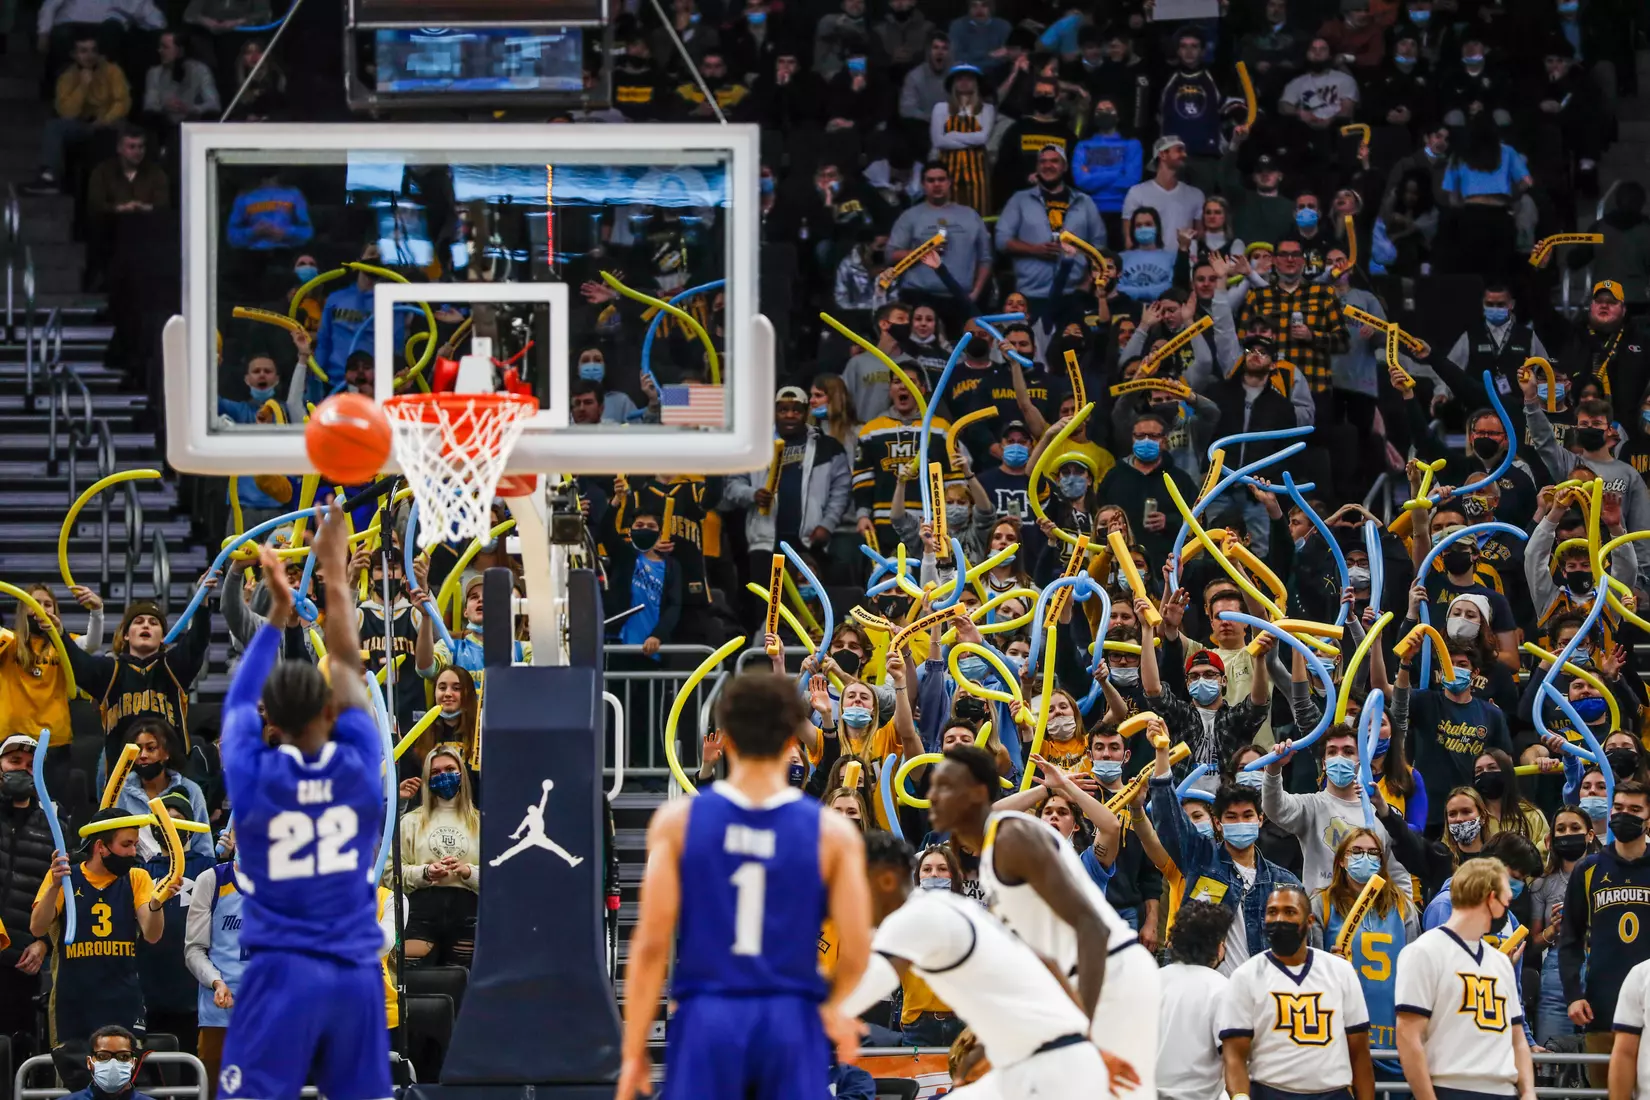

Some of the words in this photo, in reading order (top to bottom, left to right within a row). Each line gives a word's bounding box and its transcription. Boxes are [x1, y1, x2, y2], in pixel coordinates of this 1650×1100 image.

[1445, 737, 1485, 755] World
[268, 805, 359, 881] 22
[91, 902, 113, 938] 3
[730, 861, 766, 955] 1
[1618, 911, 1640, 944] 0
[65, 941, 136, 959] MARQUETTE
[1275, 992, 1334, 1046] MU
[1457, 973, 1507, 1033] MU
